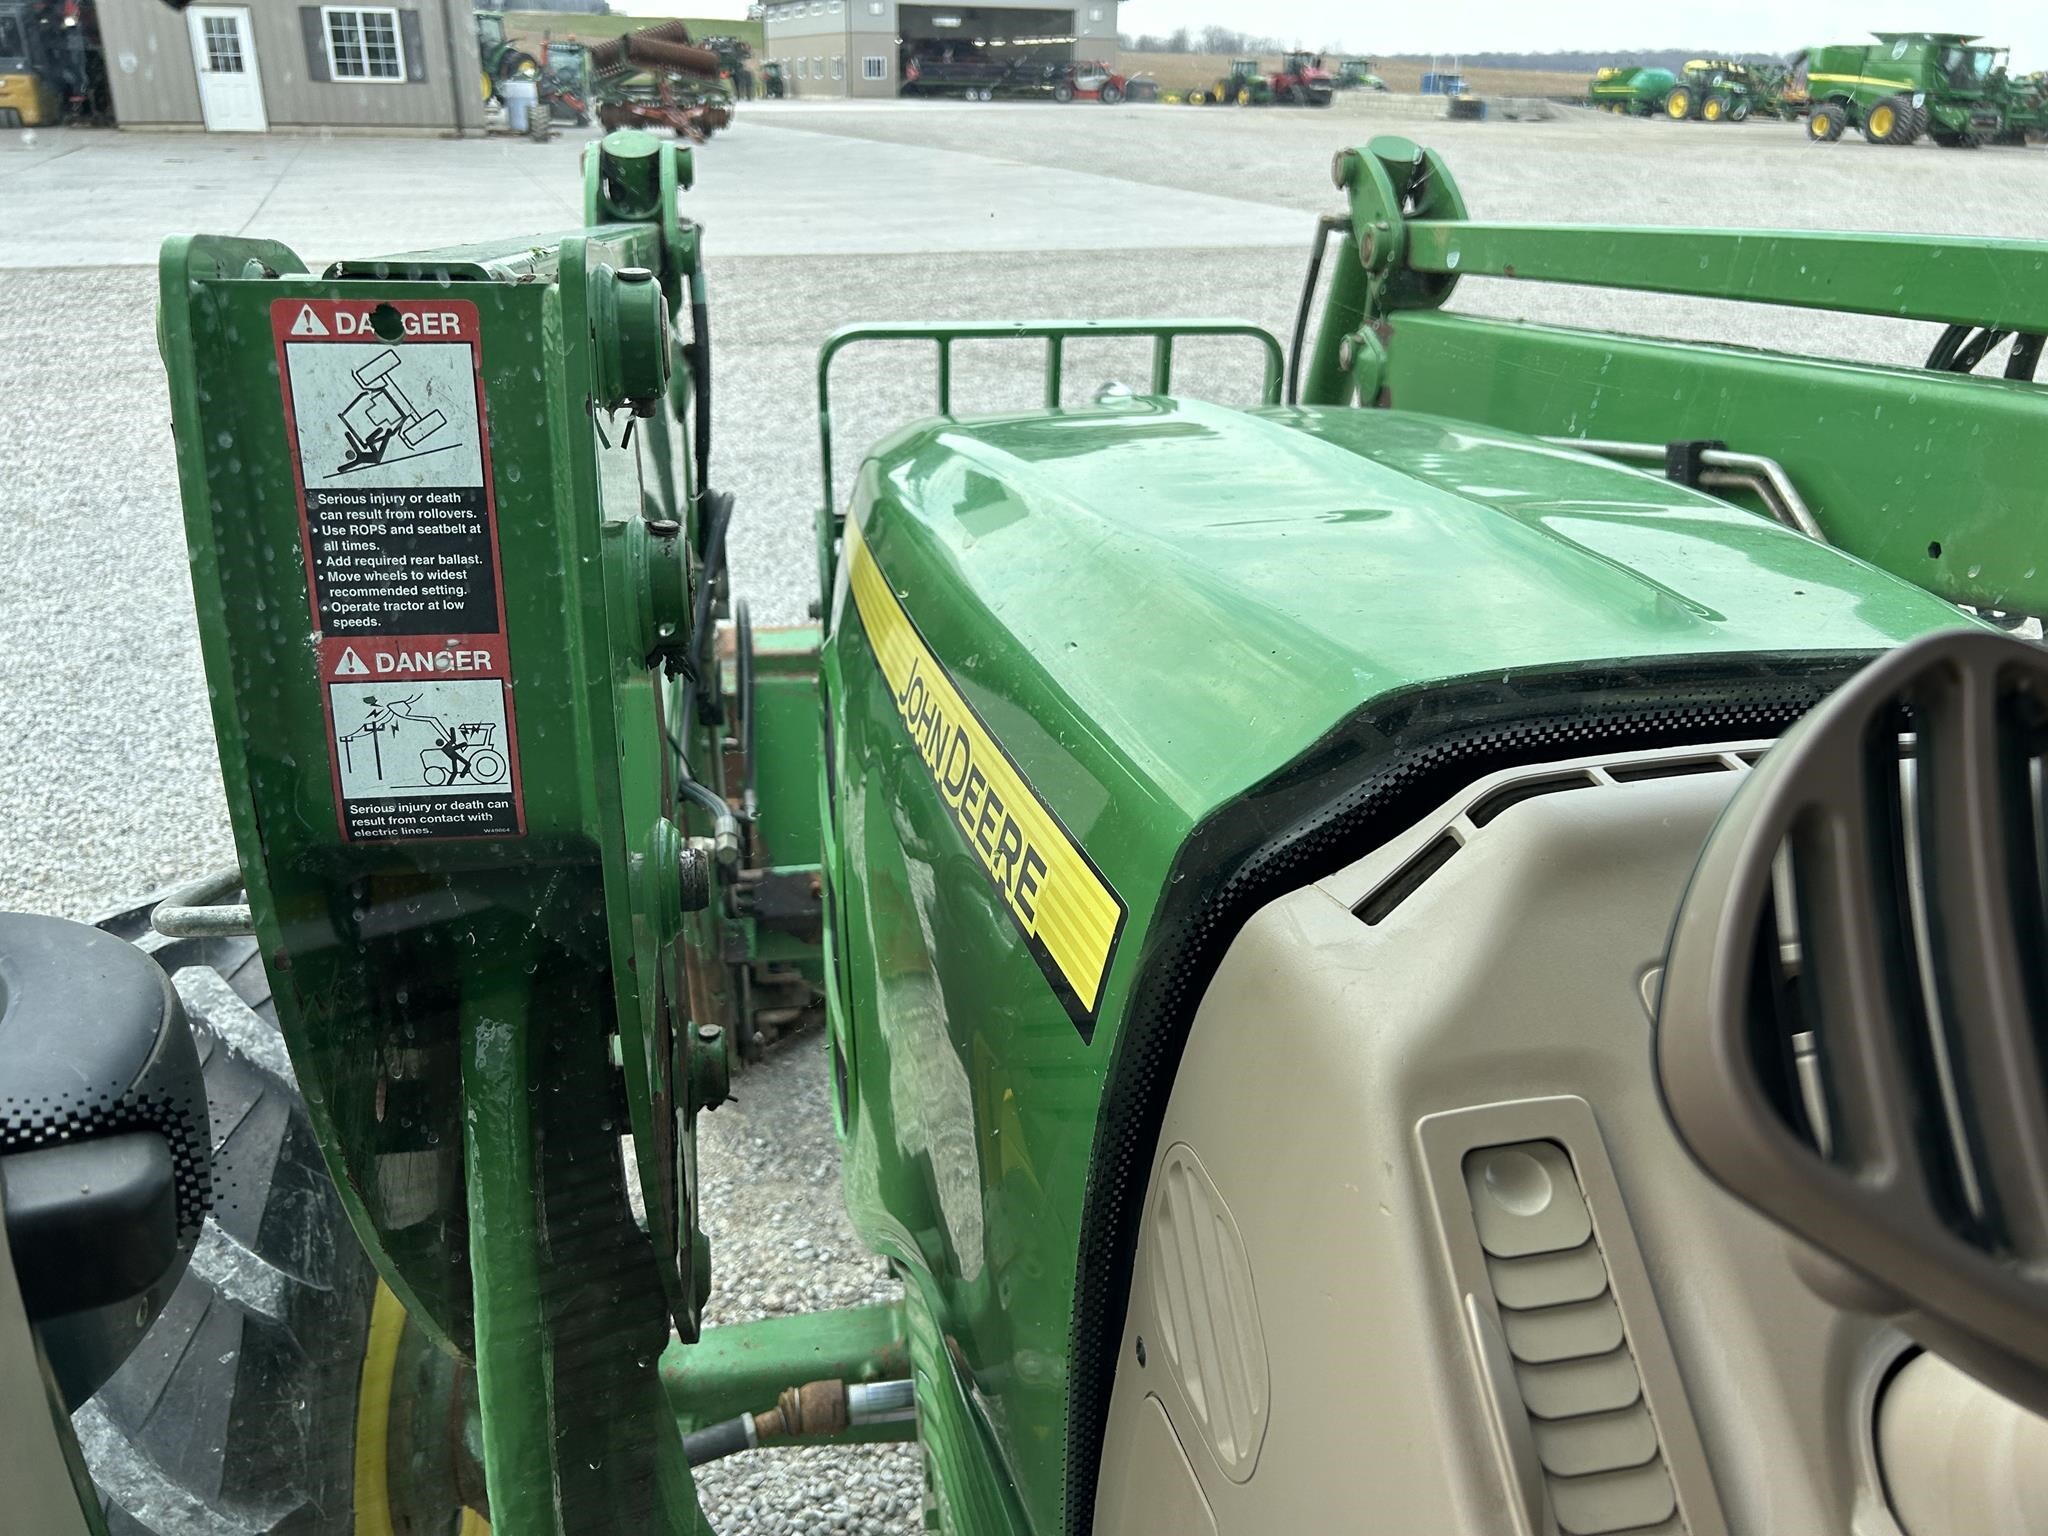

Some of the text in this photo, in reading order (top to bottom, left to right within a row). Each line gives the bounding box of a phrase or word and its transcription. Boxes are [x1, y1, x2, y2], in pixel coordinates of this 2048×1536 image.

[336, 312, 461, 336] DAGER
[318, 492, 461, 507] Serious injury or death
[320, 508, 477, 520] can result from rollovers.
[322, 523, 481, 536] Use ROPS and seatbelt at
[324, 540, 380, 551] all times.
[326, 555, 483, 569] Add required rear ballast.
[327, 569, 467, 582] Move wheels to widest
[330, 585, 468, 599] recommended setting.
[331, 599, 464, 614] Operate tractor at low
[333, 615, 381, 629] speeds.
[375, 650, 492, 673] DANGER
[350, 800, 509, 814] Serious injury or death can
[352, 813, 493, 826] result from contact with
[354, 826, 433, 837] electric lines.
